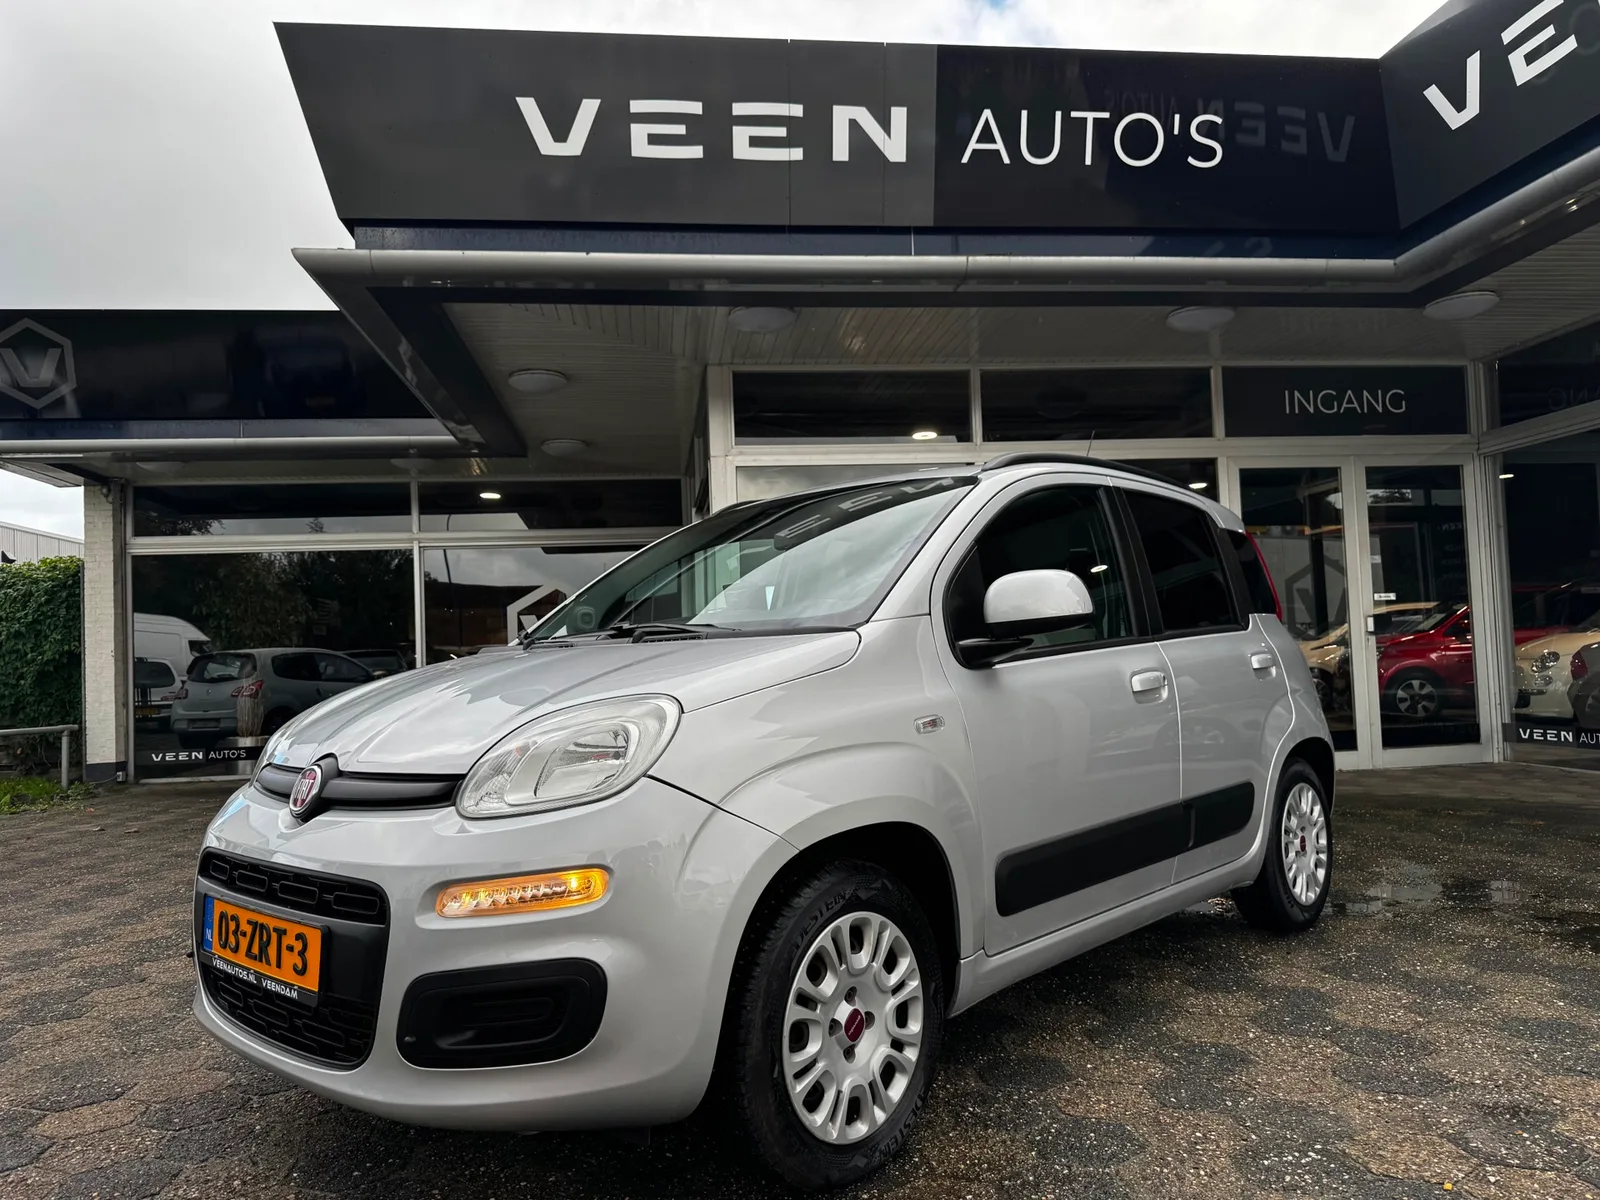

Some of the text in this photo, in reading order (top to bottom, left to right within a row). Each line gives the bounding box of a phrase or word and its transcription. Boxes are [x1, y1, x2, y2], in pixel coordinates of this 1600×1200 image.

[1423, 0, 1600, 130] VE
[515, 96, 1224, 169] VEEN AUTO'S
[1284, 389, 1406, 414] INGANG
[1519, 728, 1573, 743] VEEN
[151, 750, 247, 762] VEEN AUTO'S
[205, 928, 213, 942] NL
[217, 909, 308, 977] 03-ZRT-3
[212, 957, 298, 1000] VEENAUTOS.NL VEENDAM
